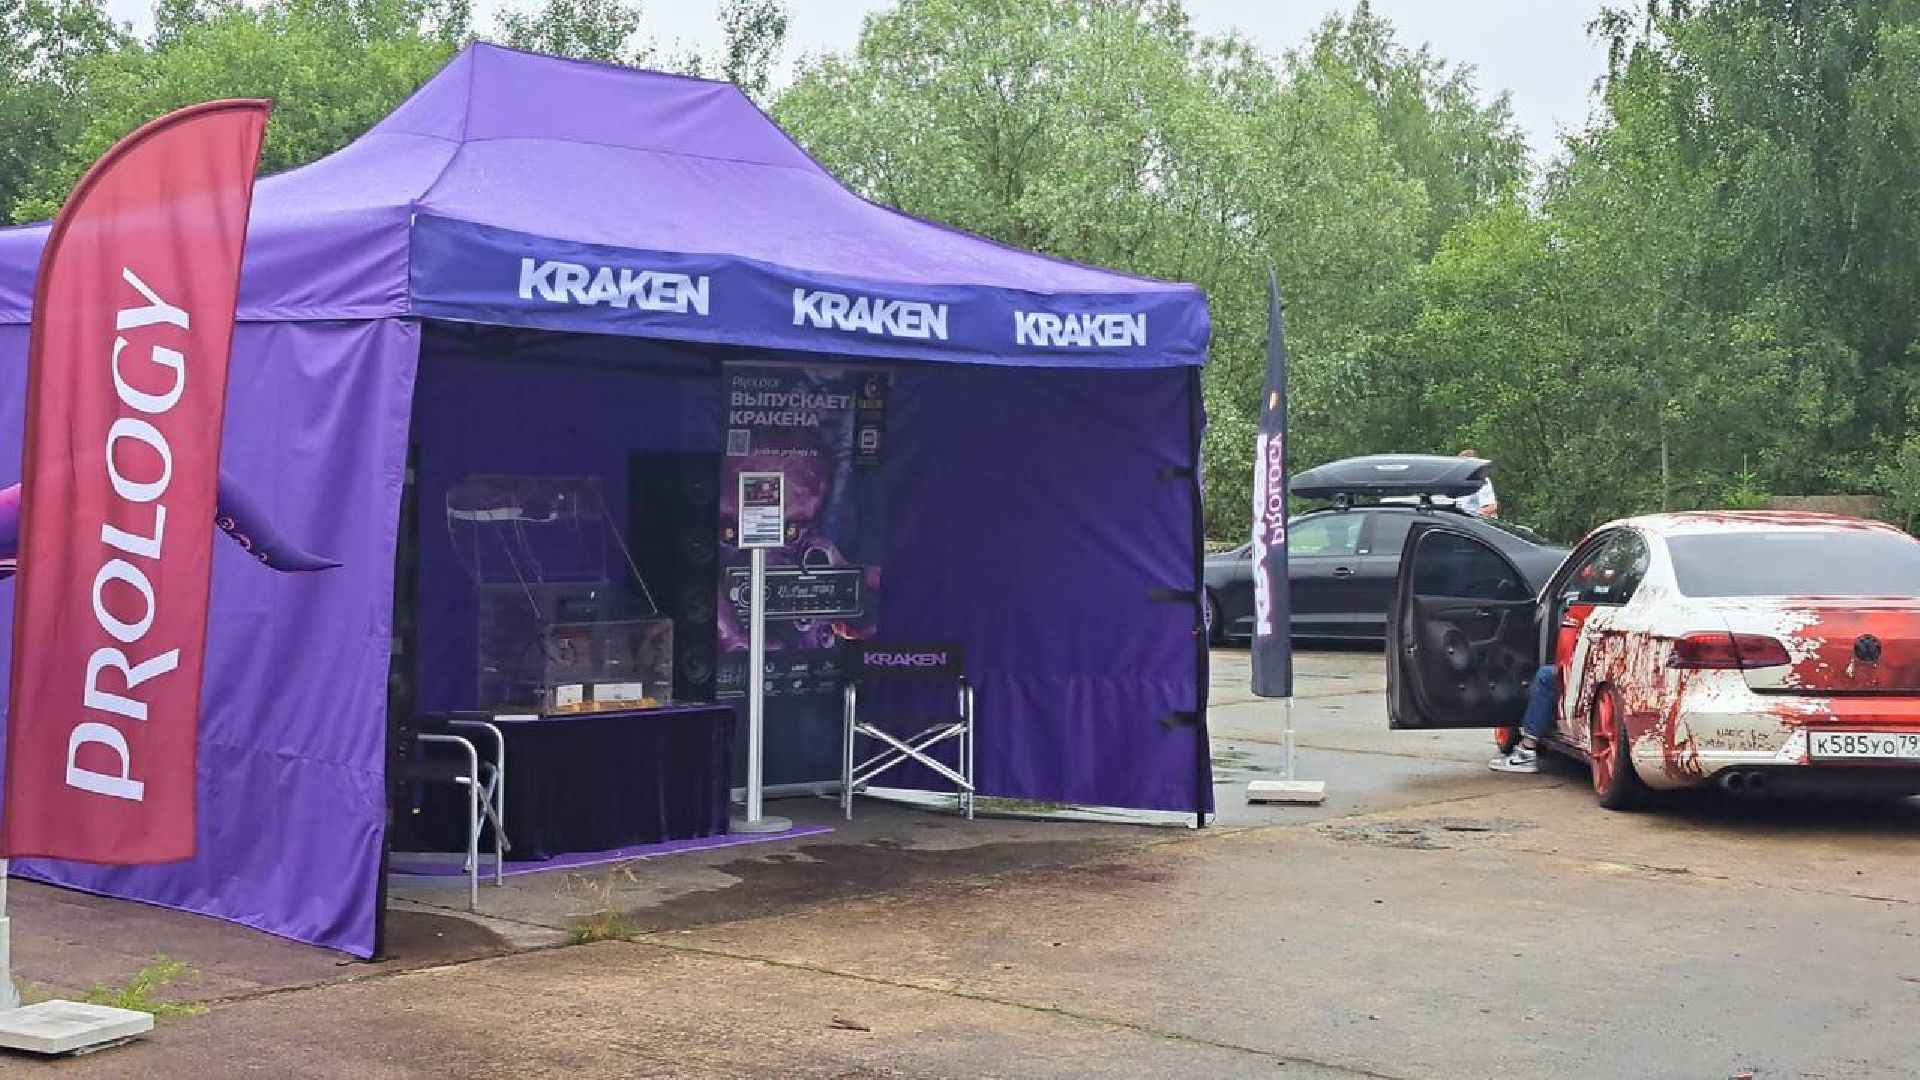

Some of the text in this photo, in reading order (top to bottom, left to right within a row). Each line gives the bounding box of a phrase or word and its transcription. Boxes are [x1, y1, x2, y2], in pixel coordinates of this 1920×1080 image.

[518, 257, 1147, 348] KRAKEN KRAKEN KRAKEN
[731, 391, 850, 410] ВЫПУСКАЕТ
[729, 410, 819, 427] КРАКЕНА
[64, 266, 191, 803] PROLOGY
[863, 650, 947, 667] KRAKEN
